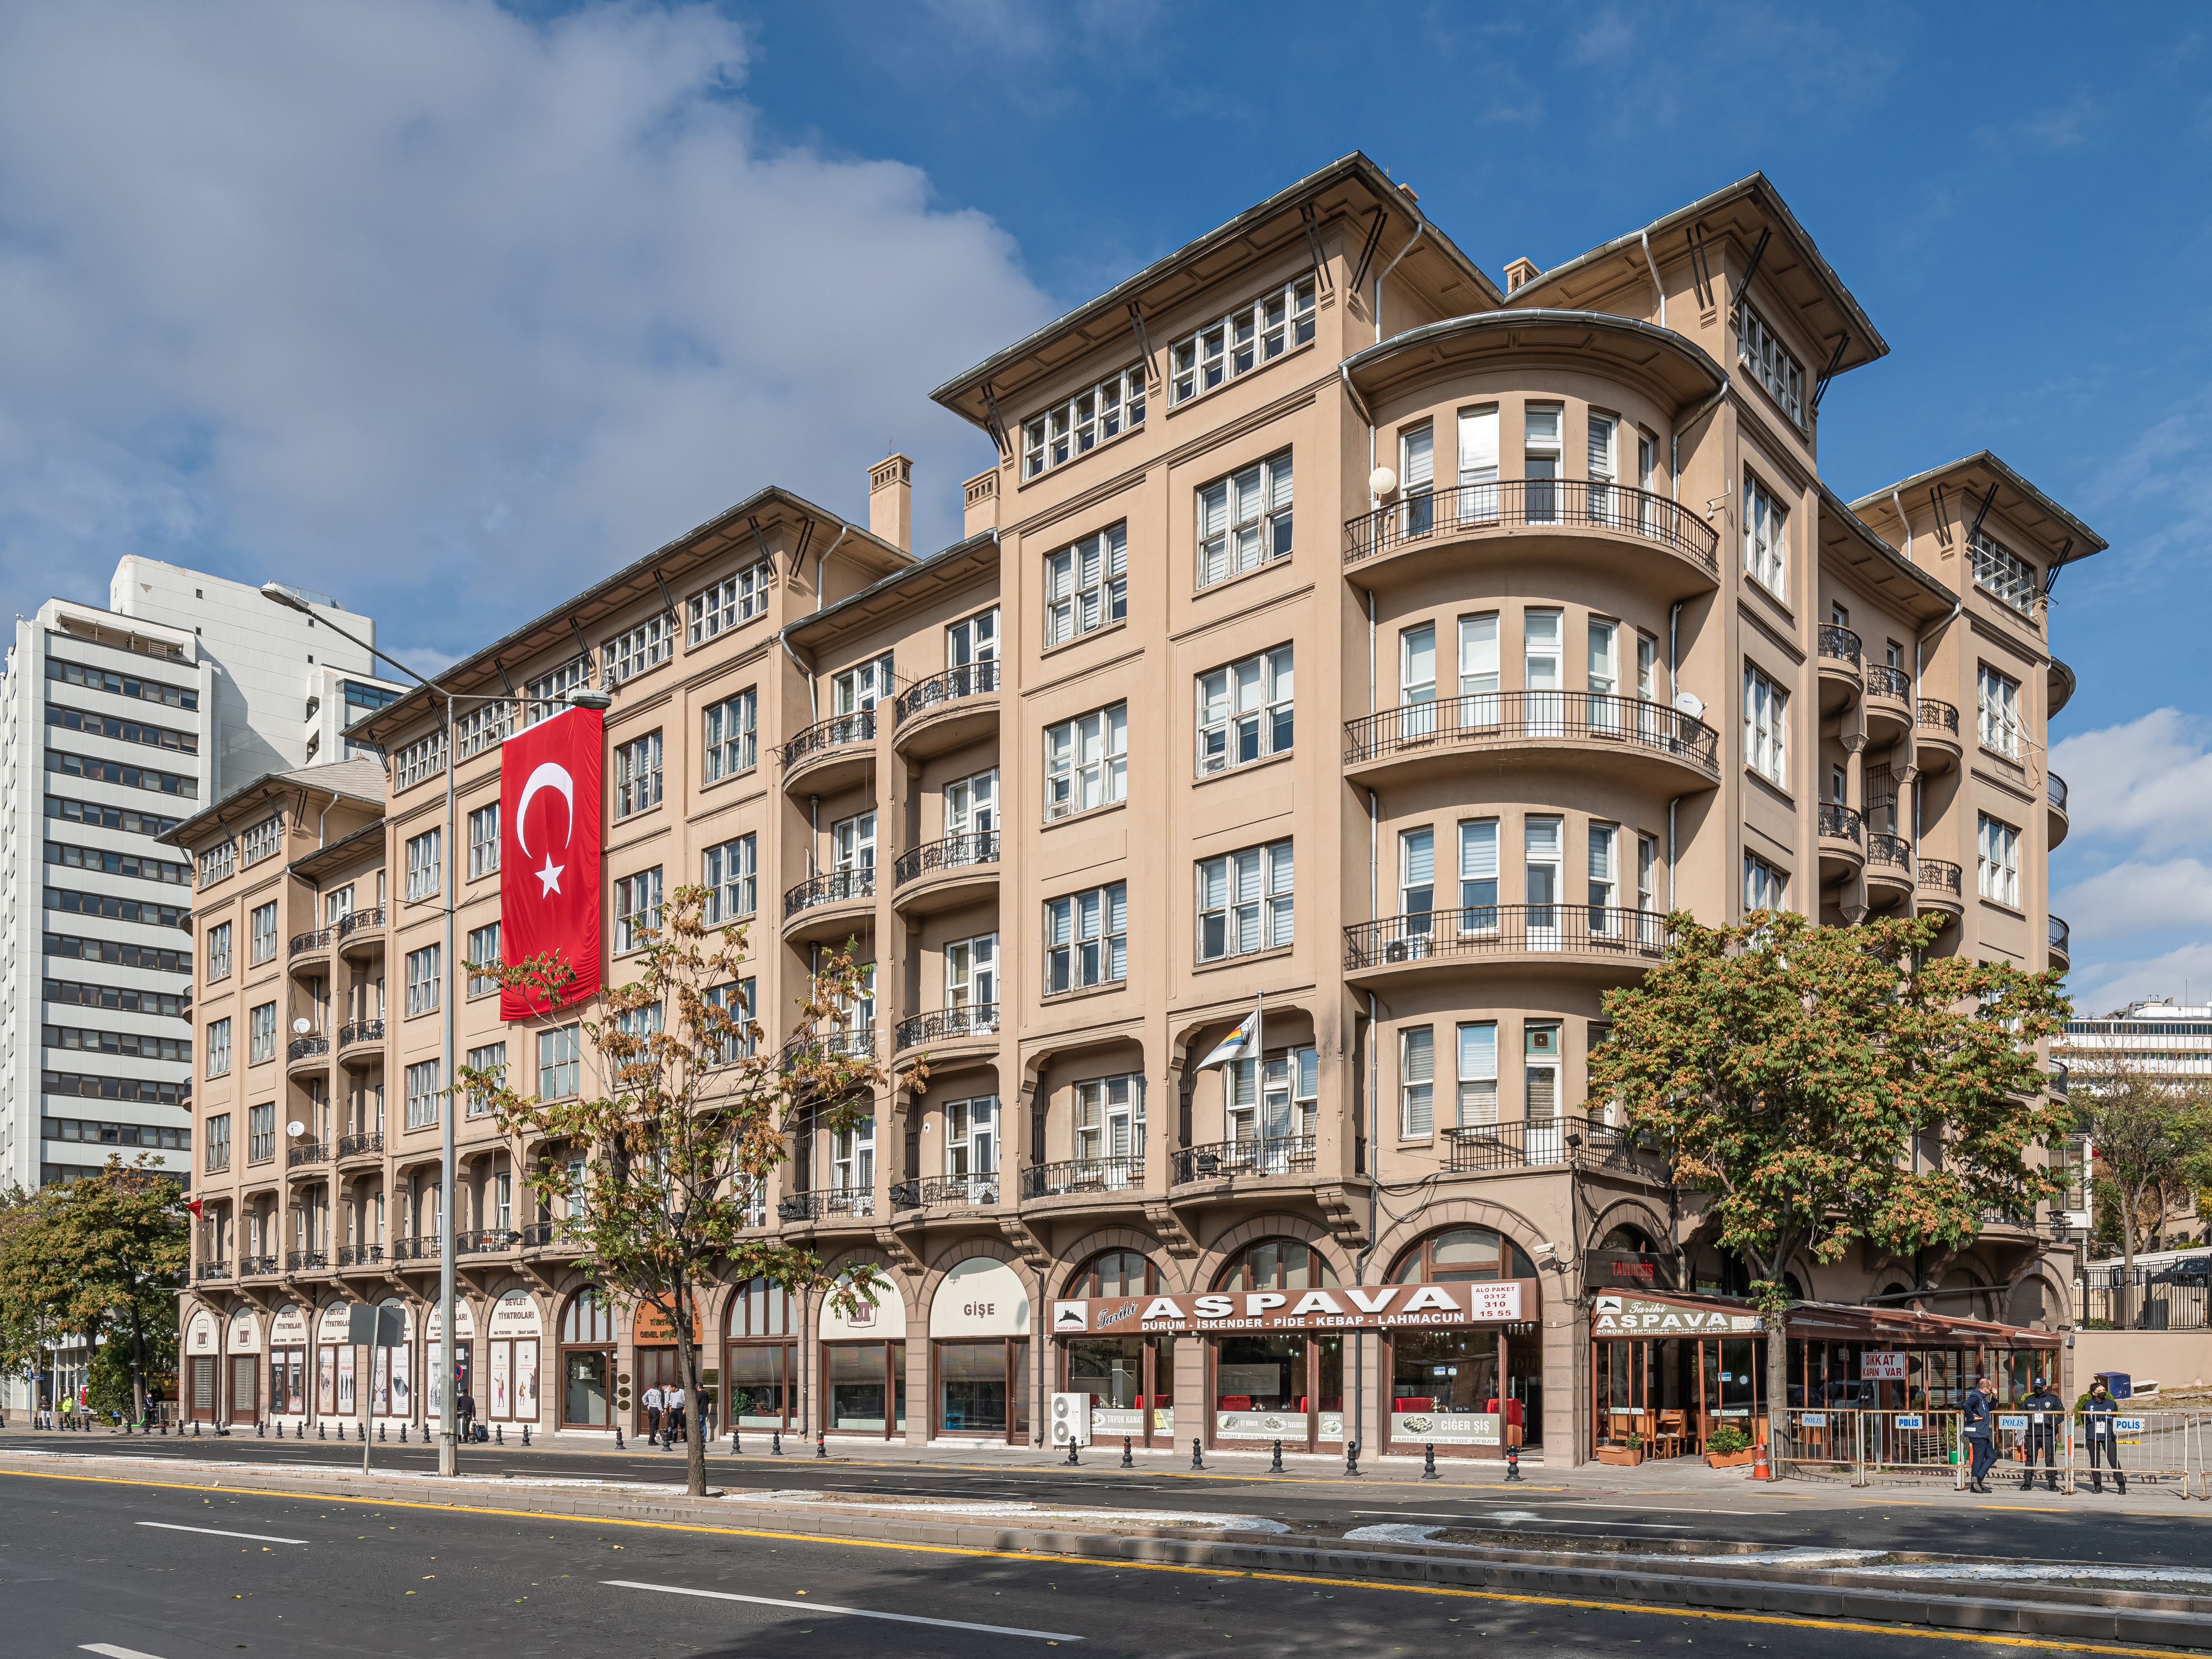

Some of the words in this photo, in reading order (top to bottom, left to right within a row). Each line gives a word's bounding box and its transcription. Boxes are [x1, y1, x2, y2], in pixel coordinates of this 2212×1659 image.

[505, 1298, 527, 1306] DEVLET
[1140, 1286, 1461, 1320] ASPAVA
[1629, 1302, 1668, 1314] Tarihi
[498, 1311, 534, 1320] TİYATROLARI
[964, 1301, 994, 1318] GİŞE
[1097, 1301, 1139, 1329] Tarihi
[1142, 1320, 1186, 1331] DÜRÜM
[1197, 1319, 1263, 1329] İSKENDER
[1273, 1316, 1305, 1327] PİDE
[1316, 1316, 1364, 1326] KEBAP
[1378, 1312, 1465, 1324] LAHMACUN
[1596, 1312, 1728, 1328] ASPAVA
[1866, 1354, 1895, 1366] DİKKAT
[1863, 1367, 1879, 1377] KAPAN
[1885, 1367, 1902, 1376] VAR
[1107, 1415, 1125, 1424] TAVUK
[1126, 1416, 1144, 1424] KANAT
[1899, 1417, 1919, 1426] POLİS
[2002, 1418, 2024, 1427] POLİS
[2116, 1419, 2140, 1429] POLİS
[1441, 1418, 1470, 1431] CİĞER
[1474, 1418, 1490, 1434] ŞİŞ
